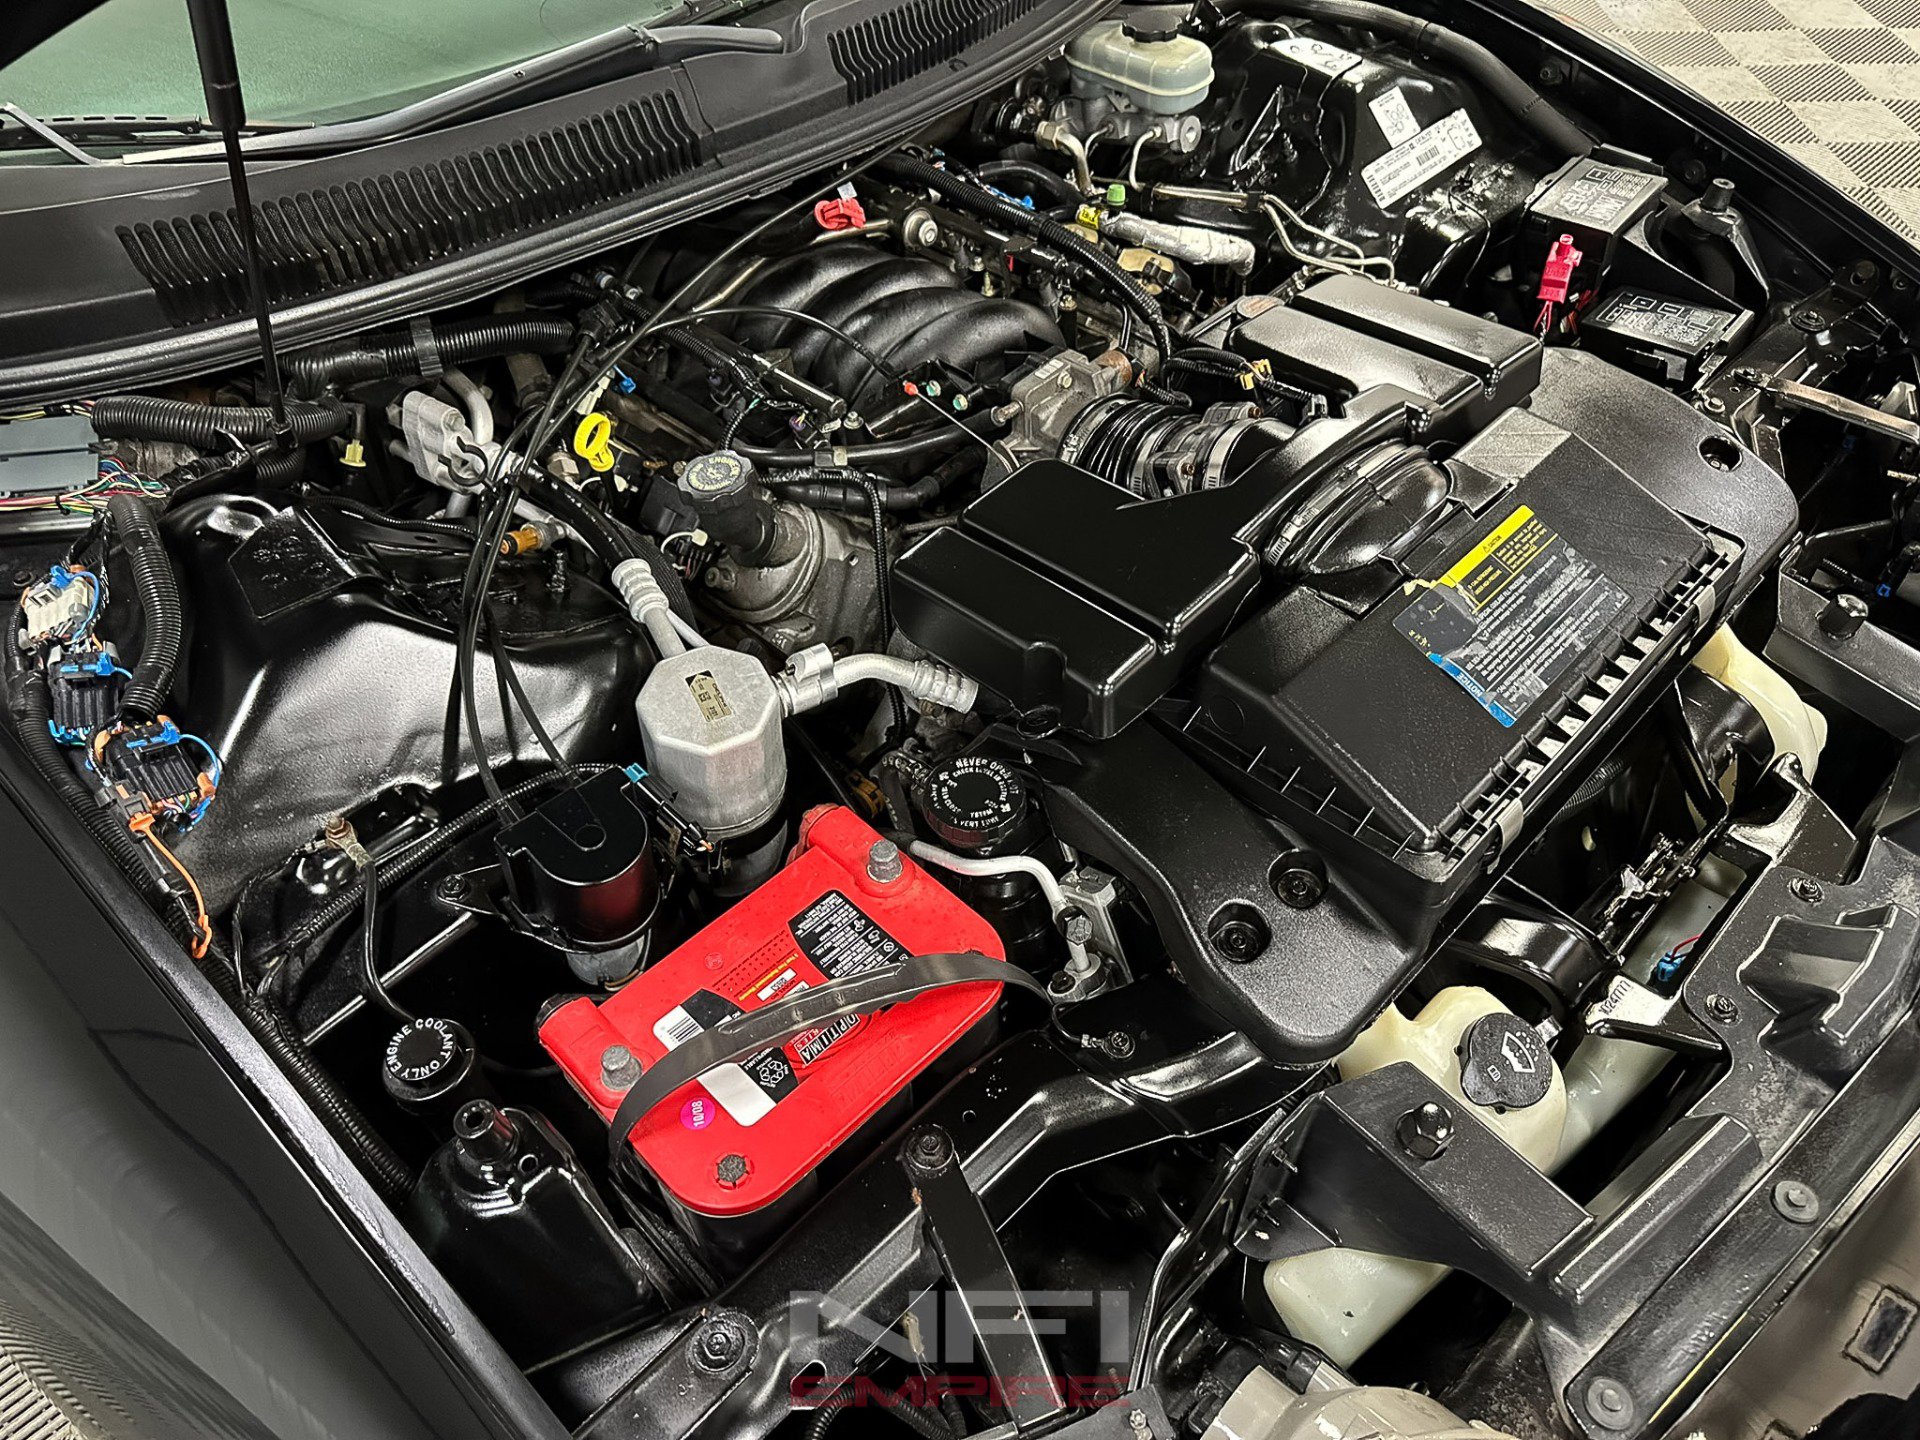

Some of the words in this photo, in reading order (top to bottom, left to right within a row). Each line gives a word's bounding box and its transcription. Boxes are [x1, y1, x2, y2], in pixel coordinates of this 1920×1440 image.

[1457, 672, 1482, 697] NOTICE
[952, 767, 974, 777] CHECK
[956, 757, 987, 768] NEVER
[386, 1024, 413, 1073] ENGINE
[415, 1018, 454, 1059] COOLANT
[801, 1013, 859, 1063] OPTIMA
[401, 1060, 440, 1079] ONLY
[693, 1100, 703, 1127] 10/08
